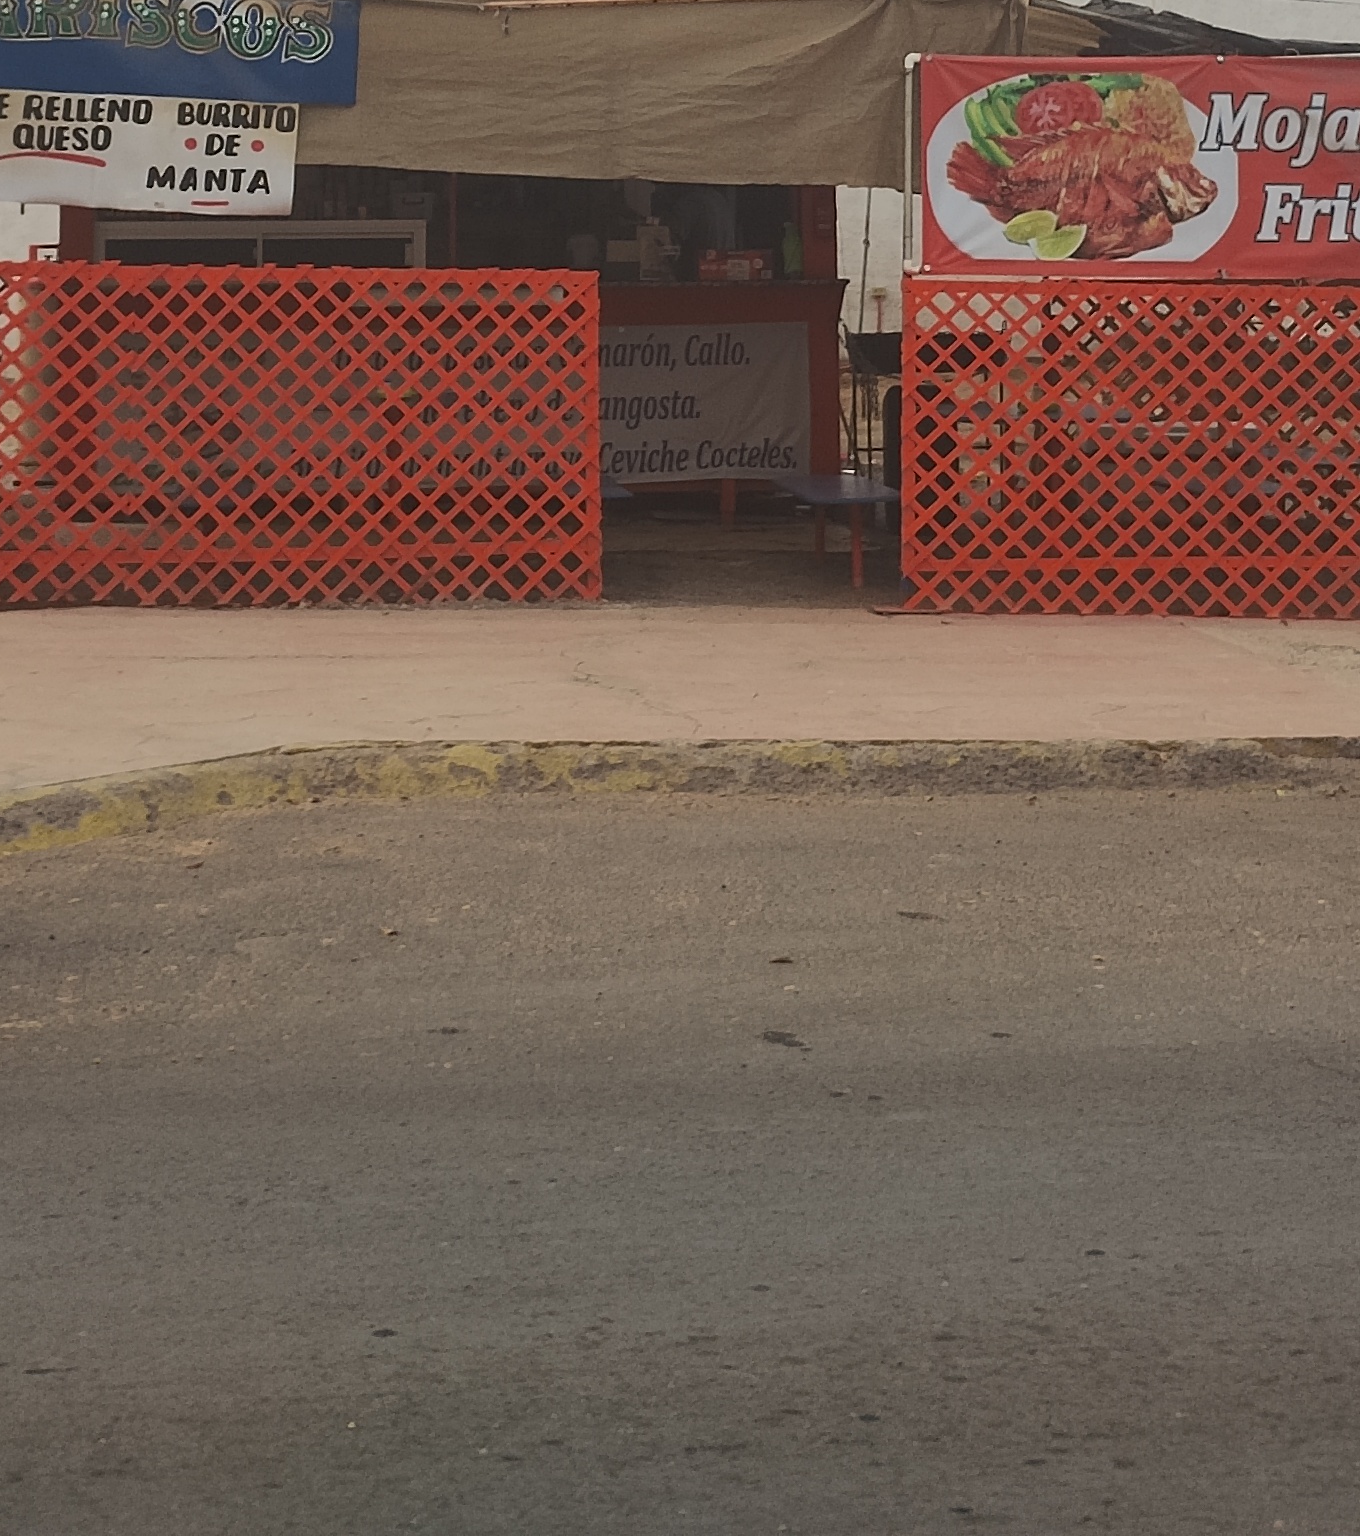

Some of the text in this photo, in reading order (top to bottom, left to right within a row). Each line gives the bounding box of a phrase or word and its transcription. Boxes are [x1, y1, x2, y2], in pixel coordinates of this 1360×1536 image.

[22, 95, 153, 125] RELLENO
[177, 101, 296, 134] BURRITO
[12, 124, 112, 153] QUESO
[204, 134, 241, 157] DE
[146, 165, 271, 196] MANTA
[684, 332, 751, 366] Callo.
[598, 440, 689, 475] Ceviche
